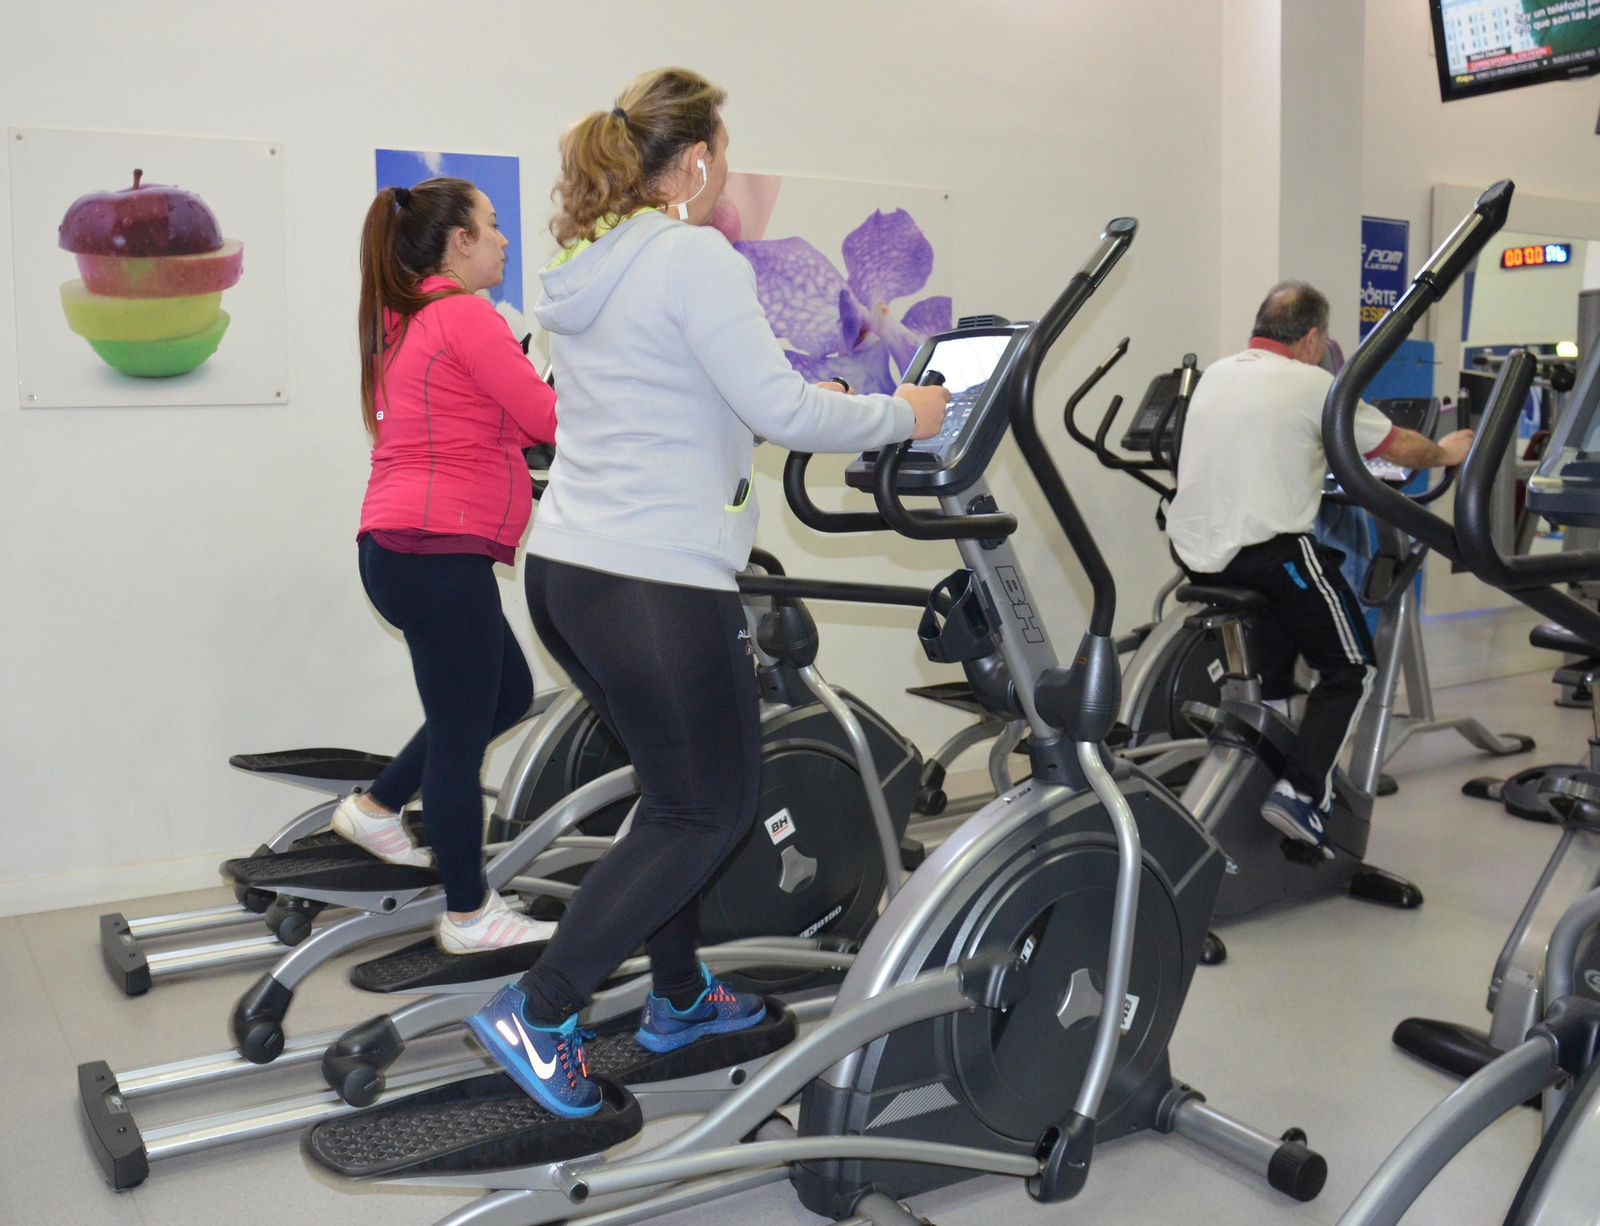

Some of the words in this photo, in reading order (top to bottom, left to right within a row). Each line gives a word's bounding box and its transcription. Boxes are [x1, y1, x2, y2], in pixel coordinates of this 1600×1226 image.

[1533, 9, 1547, 18] un
[1533, 19, 1551, 31] que
[1552, 15, 1570, 25] son
[1571, 11, 1587, 21] las
[1367, 249, 1404, 264] PDM
[995, 566, 1044, 644] BH
[771, 816, 789, 834] BH
